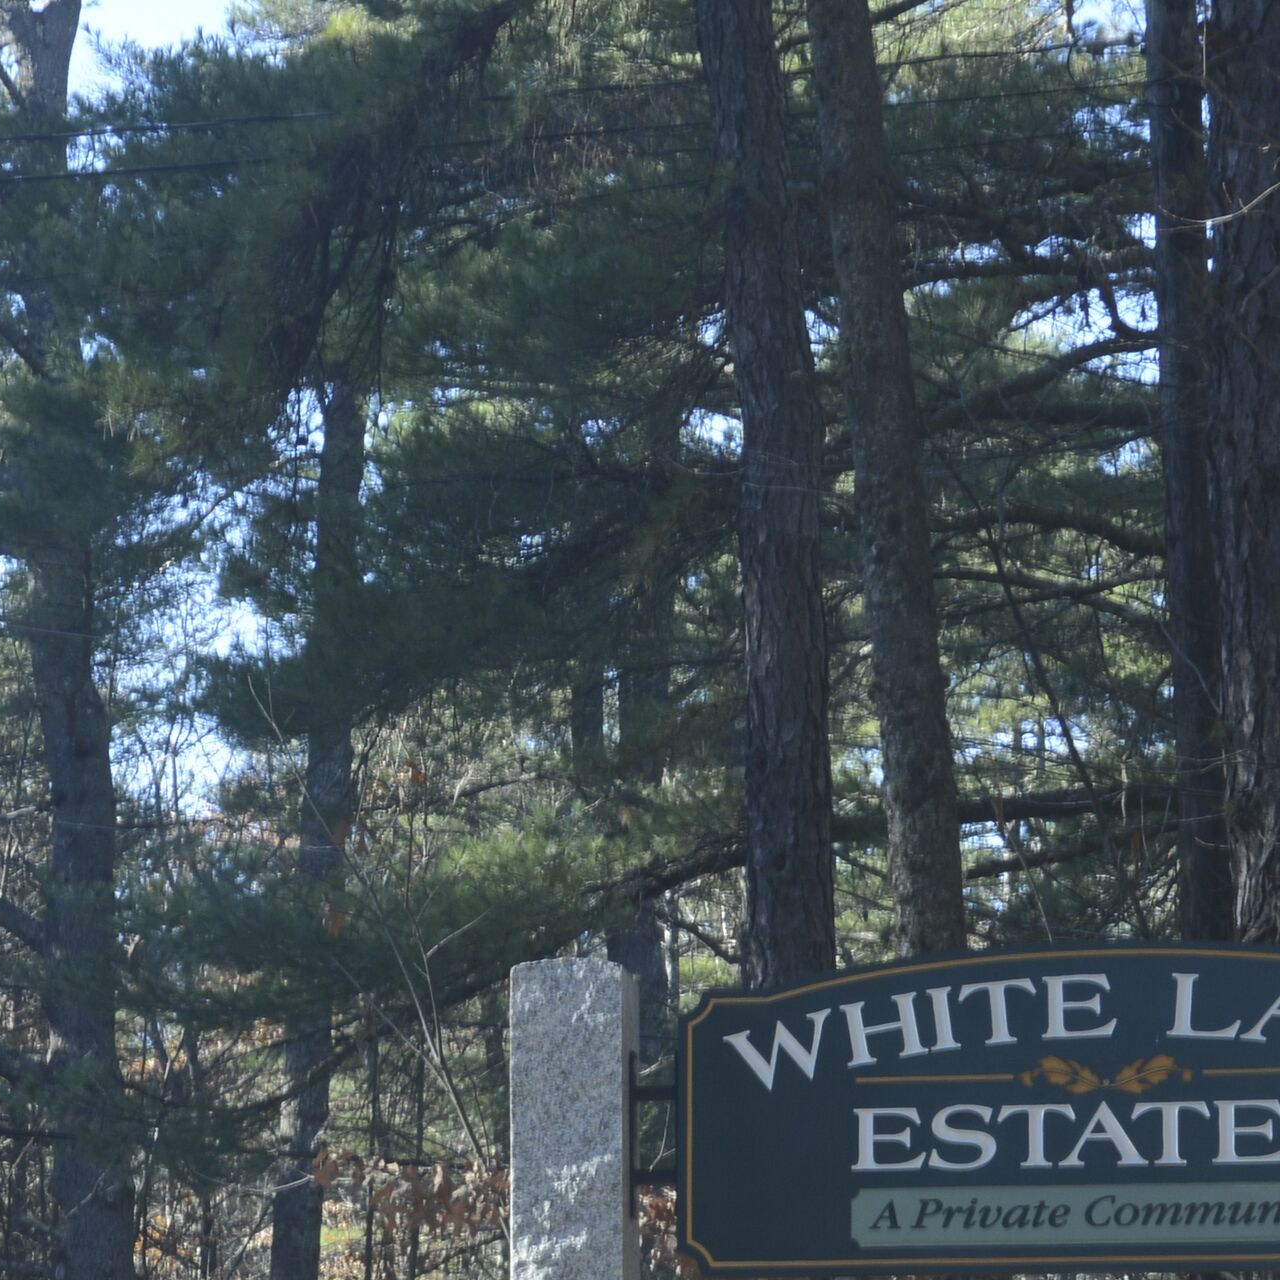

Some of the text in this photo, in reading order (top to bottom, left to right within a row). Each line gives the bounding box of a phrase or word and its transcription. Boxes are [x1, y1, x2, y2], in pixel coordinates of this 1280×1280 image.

[722, 972, 1118, 1092] WHITE
[869, 1198, 901, 1230] A
[910, 1196, 1070, 1231] Private
